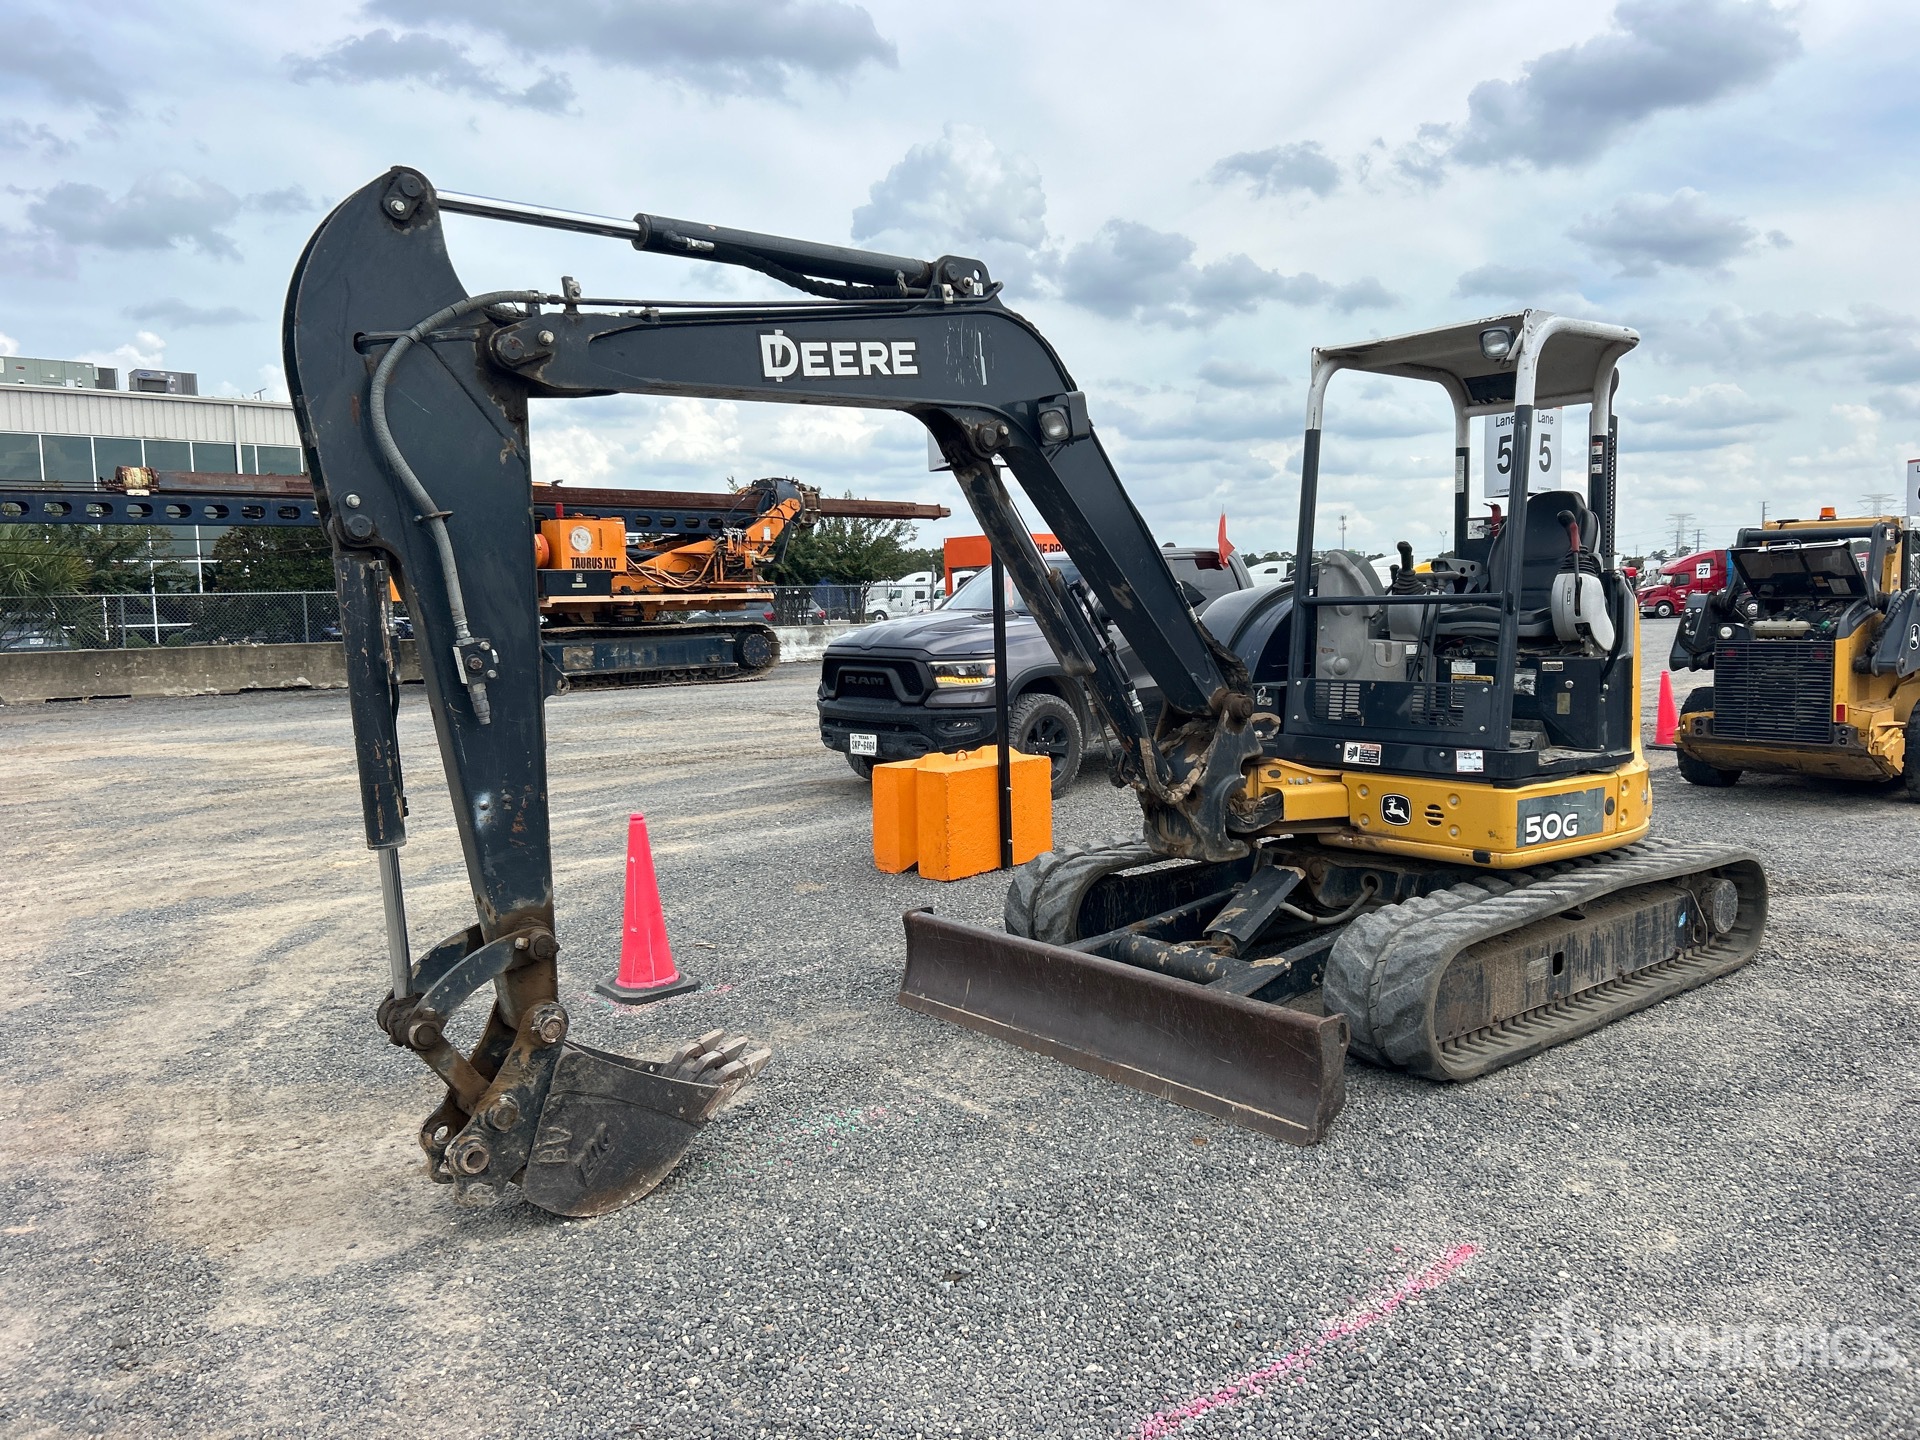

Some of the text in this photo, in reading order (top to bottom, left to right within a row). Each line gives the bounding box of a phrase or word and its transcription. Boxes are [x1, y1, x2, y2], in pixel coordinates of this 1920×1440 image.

[760, 329, 918, 383] DEERE
[1495, 415, 1515, 428] Lane
[1537, 411, 1554, 425] Lane
[1497, 434, 1512, 475] 5
[1539, 433, 1552, 473] 5
[570, 556, 617, 569] TAURUS XLT
[1698, 567, 1709, 575] 27
[844, 675, 885, 685] RAM
[1525, 812, 1579, 845] 50G
